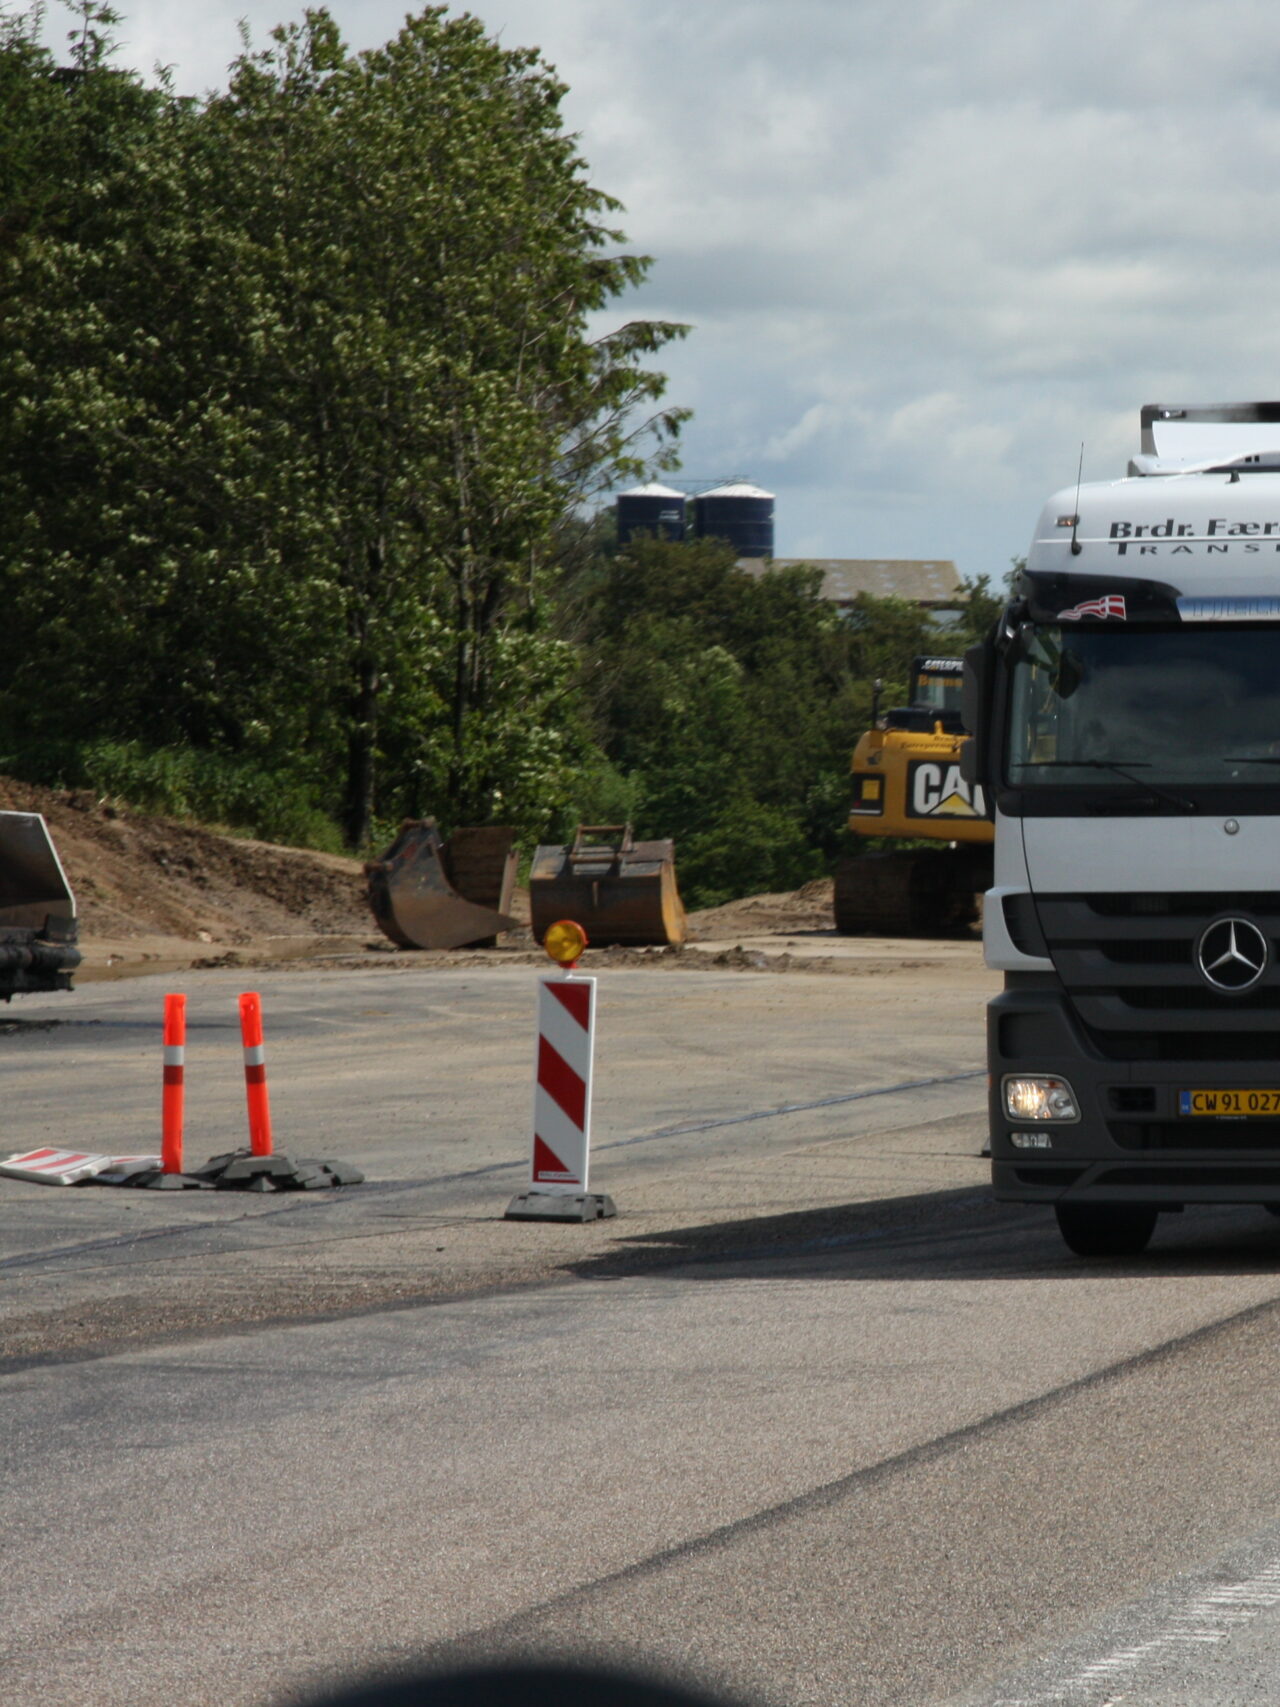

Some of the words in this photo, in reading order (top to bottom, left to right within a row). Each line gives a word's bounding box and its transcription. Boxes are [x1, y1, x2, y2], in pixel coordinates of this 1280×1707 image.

[1110, 519, 1195, 539] Brdr.
[1193, 1093, 1217, 1111] CW
[1221, 1093, 1241, 1111] 91
